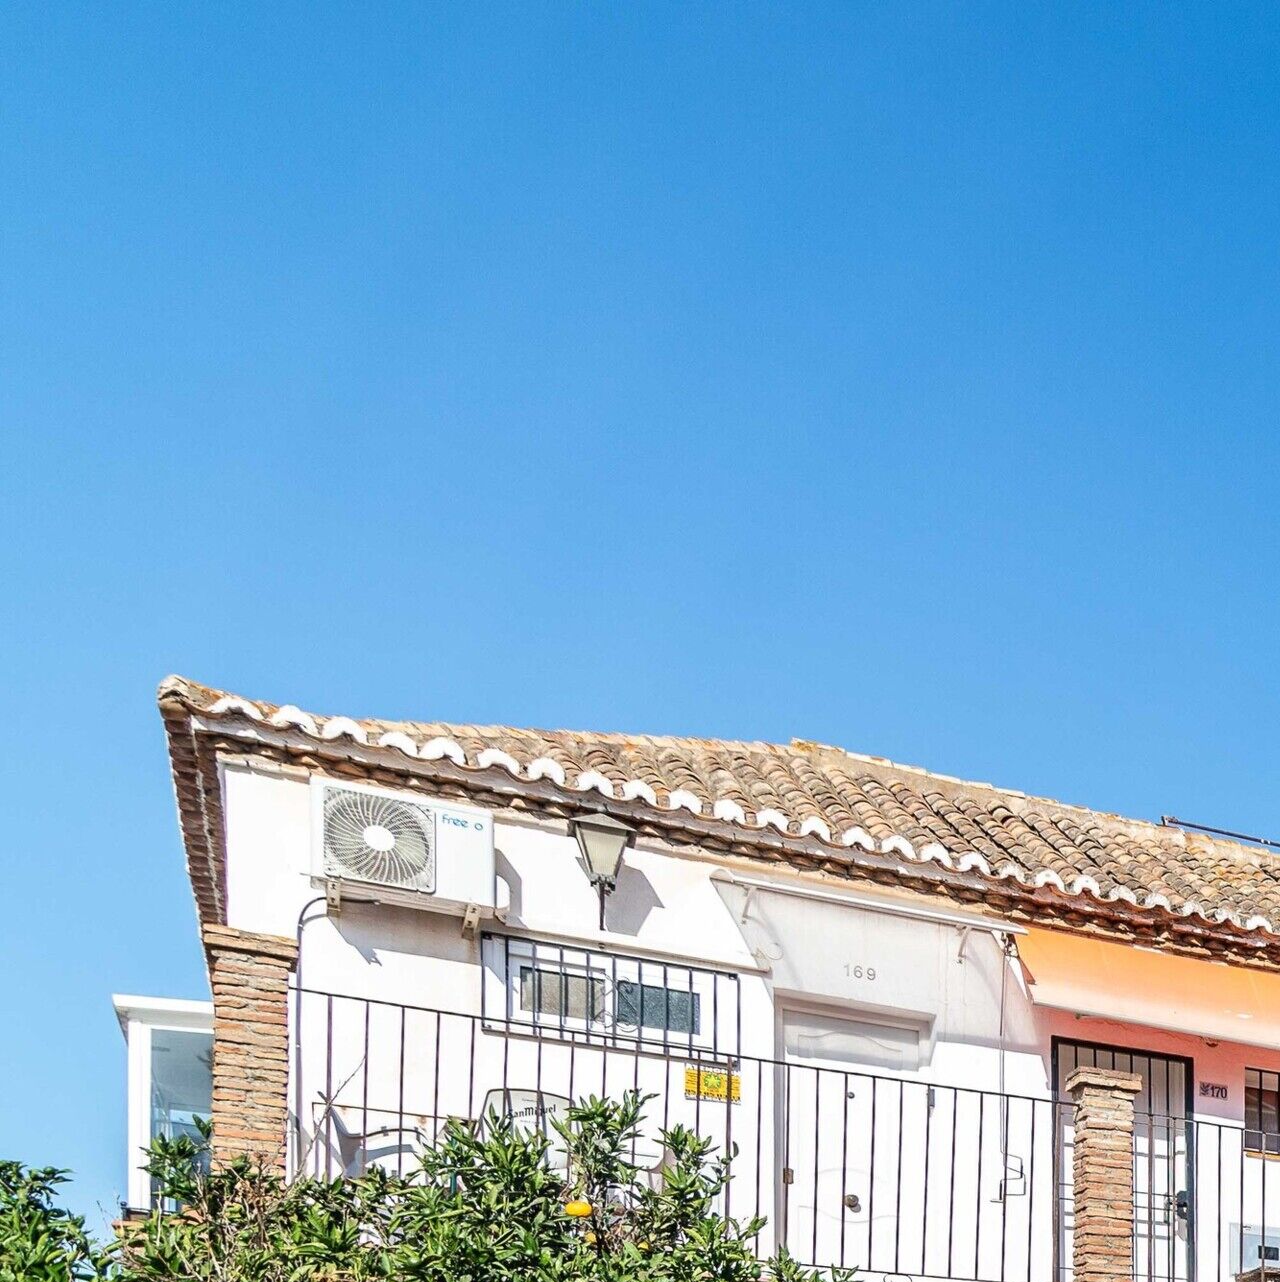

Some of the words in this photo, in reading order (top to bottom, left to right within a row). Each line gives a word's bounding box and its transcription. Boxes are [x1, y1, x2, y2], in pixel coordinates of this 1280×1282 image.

[844, 963, 876, 981] 169
[1211, 1086, 1228, 1099] 170
[508, 1103, 557, 1119] SanMiuel
